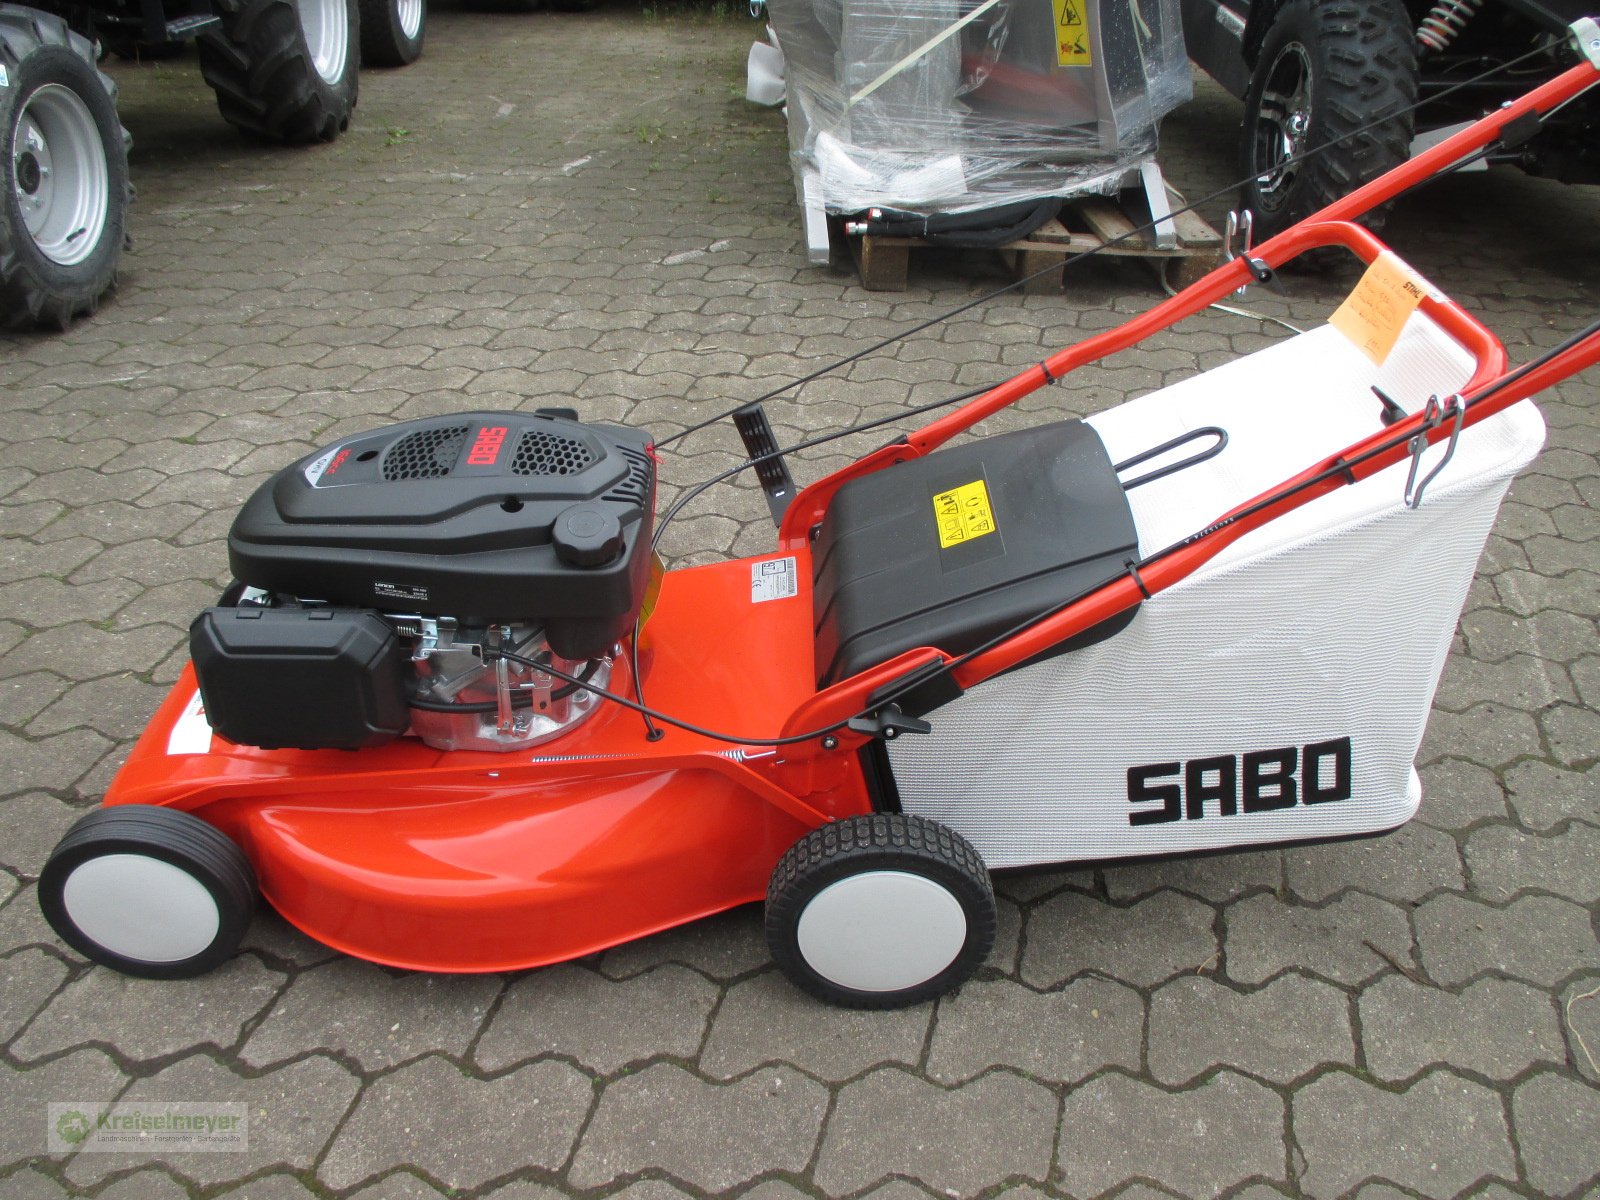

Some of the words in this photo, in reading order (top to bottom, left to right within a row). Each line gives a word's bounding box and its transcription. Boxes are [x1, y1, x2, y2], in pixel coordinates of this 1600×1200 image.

[1403, 281, 1422, 299] STIHL
[467, 427, 508, 464] SABO
[1127, 736, 1351, 826] SABO
